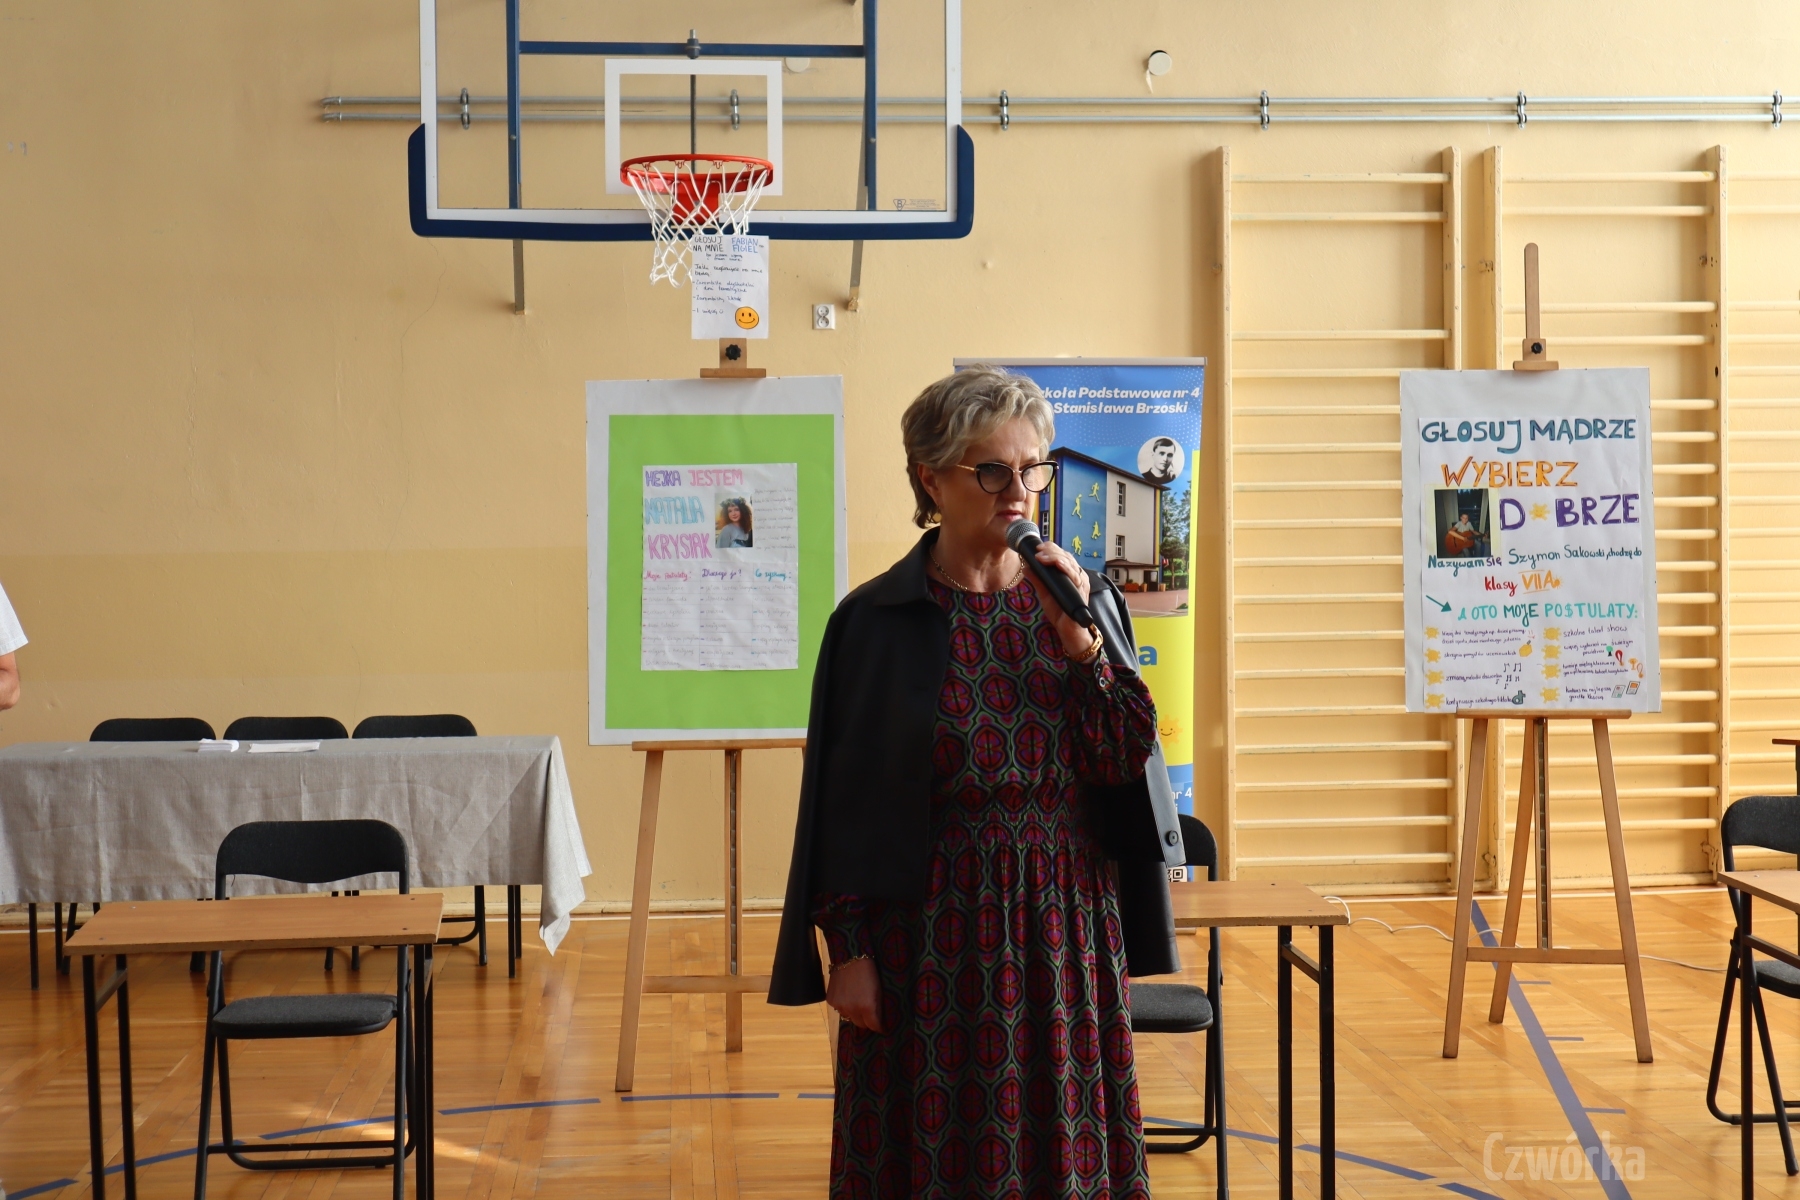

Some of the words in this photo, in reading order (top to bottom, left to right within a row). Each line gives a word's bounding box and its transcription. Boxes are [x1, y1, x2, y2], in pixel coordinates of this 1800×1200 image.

[693, 245, 703, 253] NA
[704, 244, 724, 253] MNIE
[694, 235, 723, 244] GŁOSUJ
[731, 237, 759, 246] FABIAN
[732, 244, 759, 254] FIGIEL
[1043, 387, 1077, 399] koła
[1078, 387, 1171, 399] Podstawowa
[1173, 389, 1188, 399] nr
[1190, 387, 1200, 398] 4
[1053, 402, 1134, 414] Stanisława
[1136, 401, 1188, 414] Brzóski
[1421, 419, 1522, 454] GŁOSUJ
[1529, 418, 1636, 445] MĄDRZE
[645, 470, 682, 487] HEJKA
[688, 468, 744, 487] JESTEM
[1440, 456, 1579, 488] WYBIERZ
[644, 496, 705, 525] NATALIA
[648, 533, 713, 560] KRYSIAK
[1509, 548, 1561, 569] Szymon
[1484, 576, 1519, 597] klasy
[1471, 604, 1498, 620] OTO
[1504, 603, 1539, 628] MOJE
[1184, 786, 1193, 798] 4
